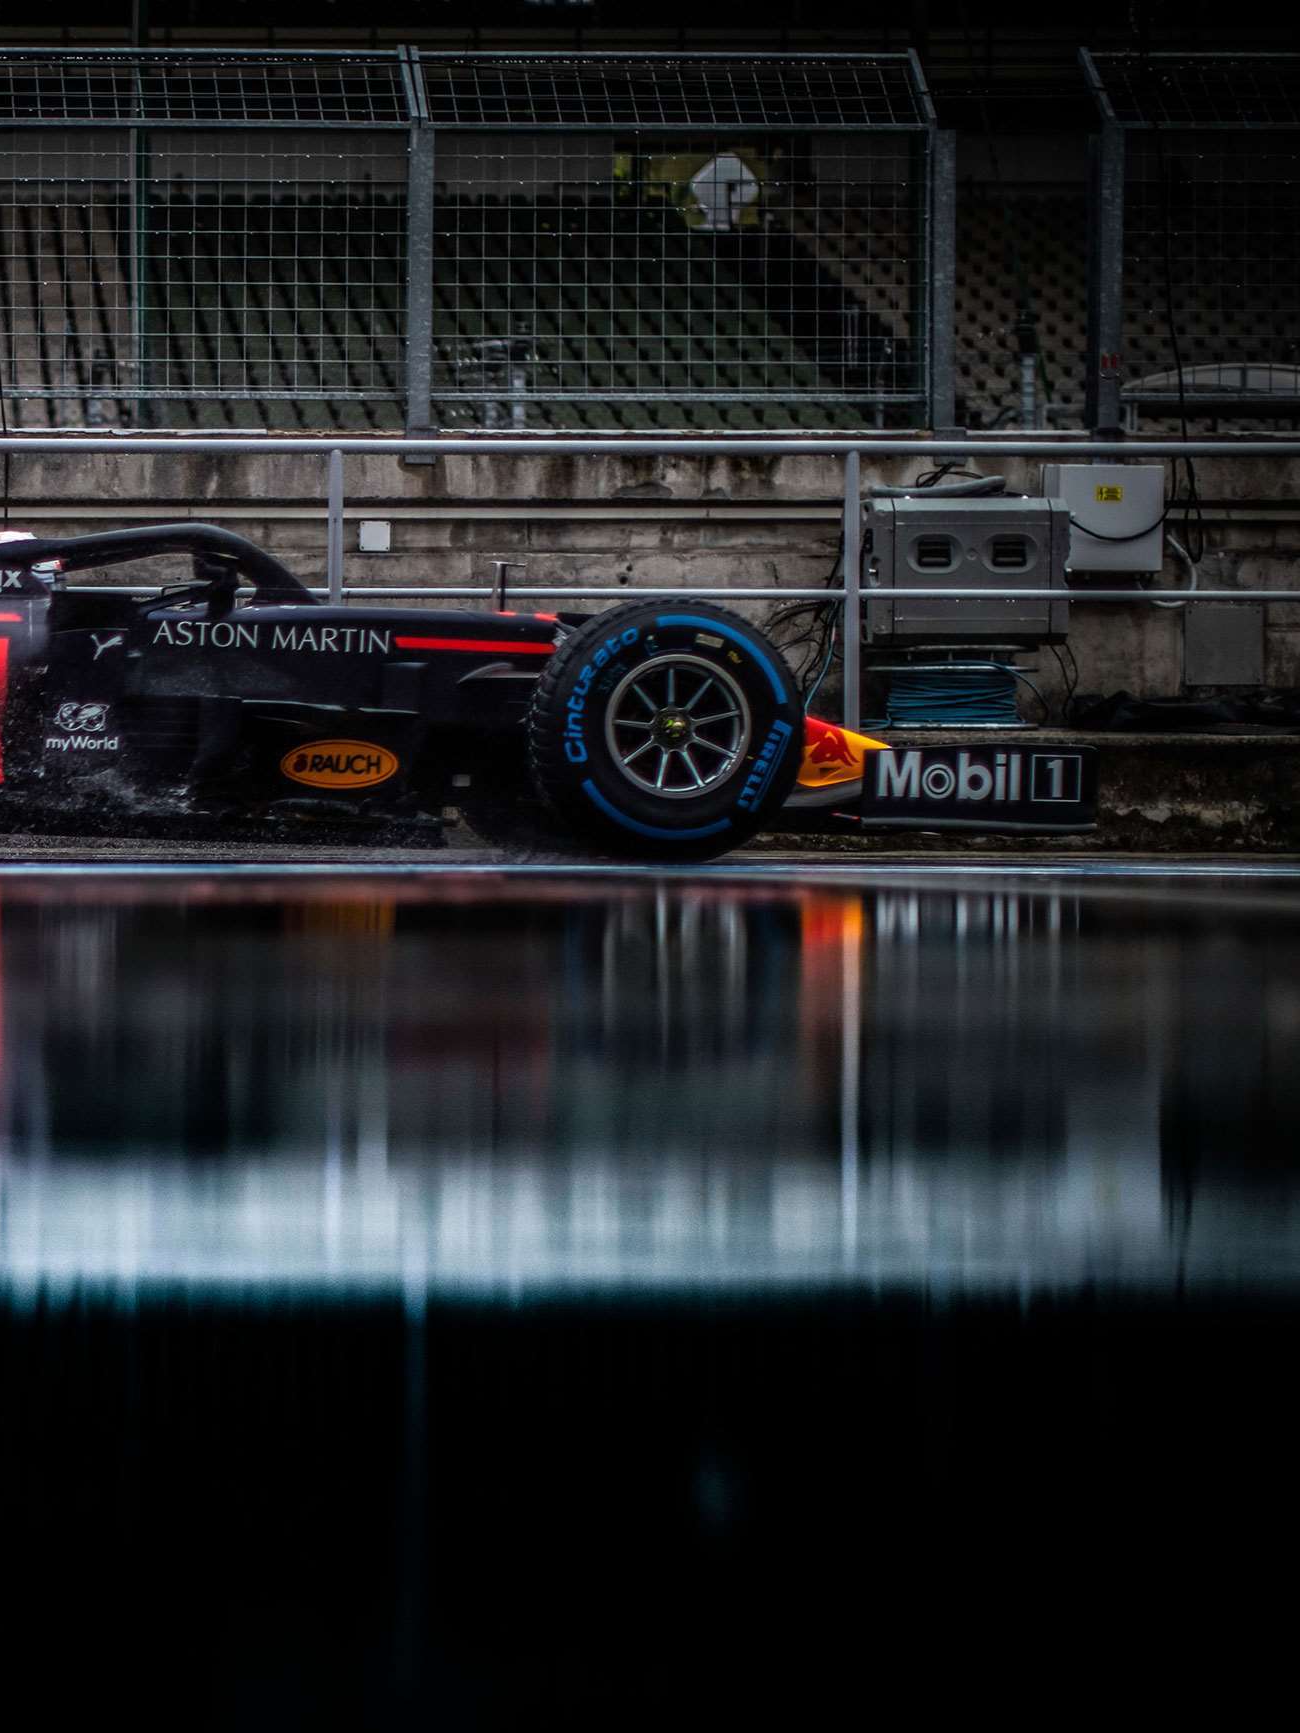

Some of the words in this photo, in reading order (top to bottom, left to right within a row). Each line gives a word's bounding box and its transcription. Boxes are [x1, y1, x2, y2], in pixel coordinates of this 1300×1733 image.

[154, 620, 259, 649] ASTON
[272, 625, 391, 654] MARTIN
[564, 626, 640, 763] Cinturato
[46, 735, 118, 751] myWorld
[308, 760, 381, 775] RAUCH
[736, 719, 793, 812] PIRELLI
[876, 750, 1021, 801] Mobil
[1046, 759, 1066, 798] 1
